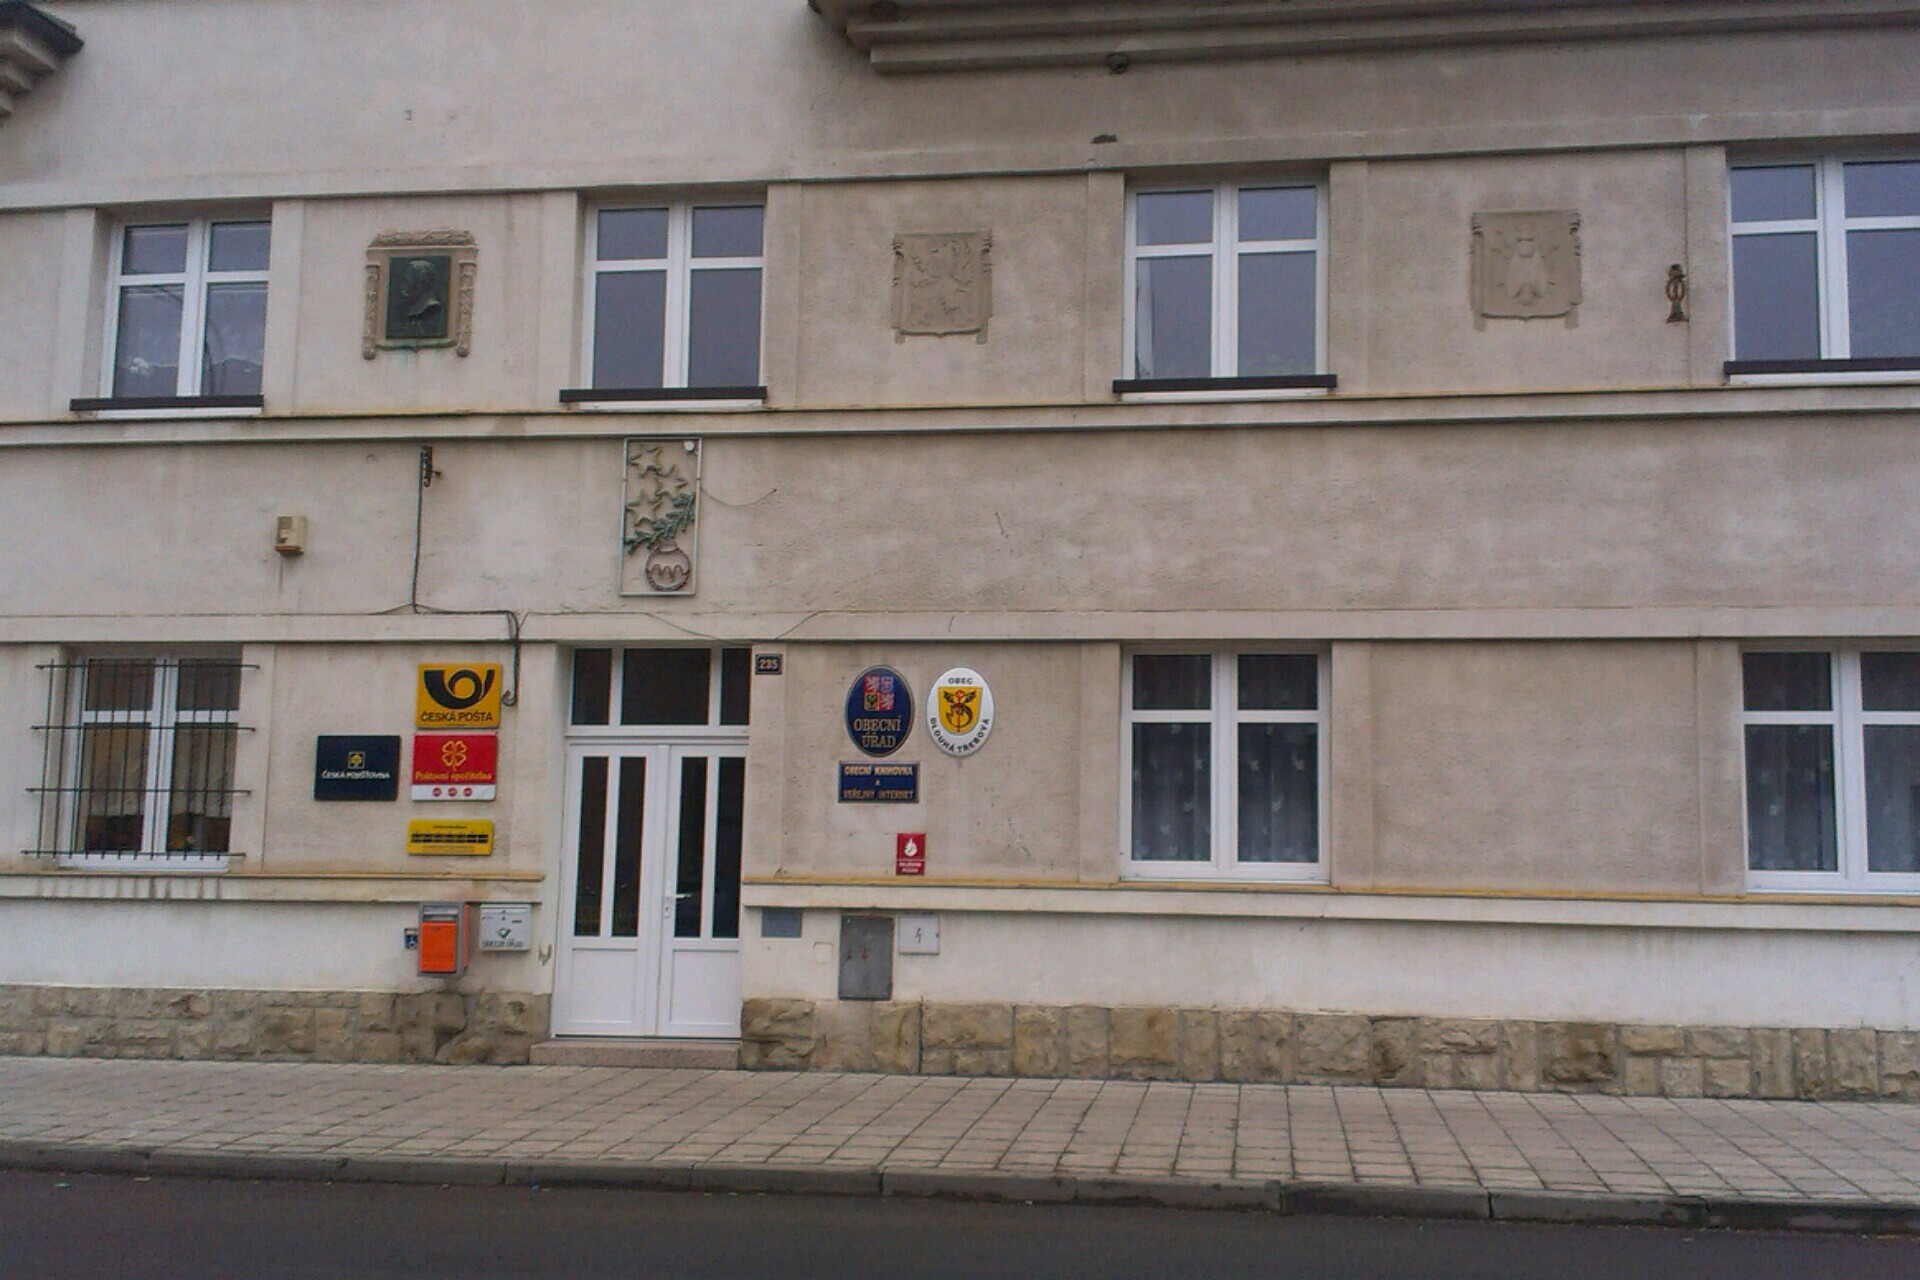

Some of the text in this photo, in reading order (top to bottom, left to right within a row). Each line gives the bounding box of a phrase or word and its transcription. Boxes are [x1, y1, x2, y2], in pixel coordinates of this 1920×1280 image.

[759, 658, 778, 669] 235
[948, 677, 974, 685] OBEC
[420, 709, 493, 722] ČESKÁ POŠTA
[853, 715, 902, 732] OBECNÍ
[861, 731, 897, 748] ÚŘAD
